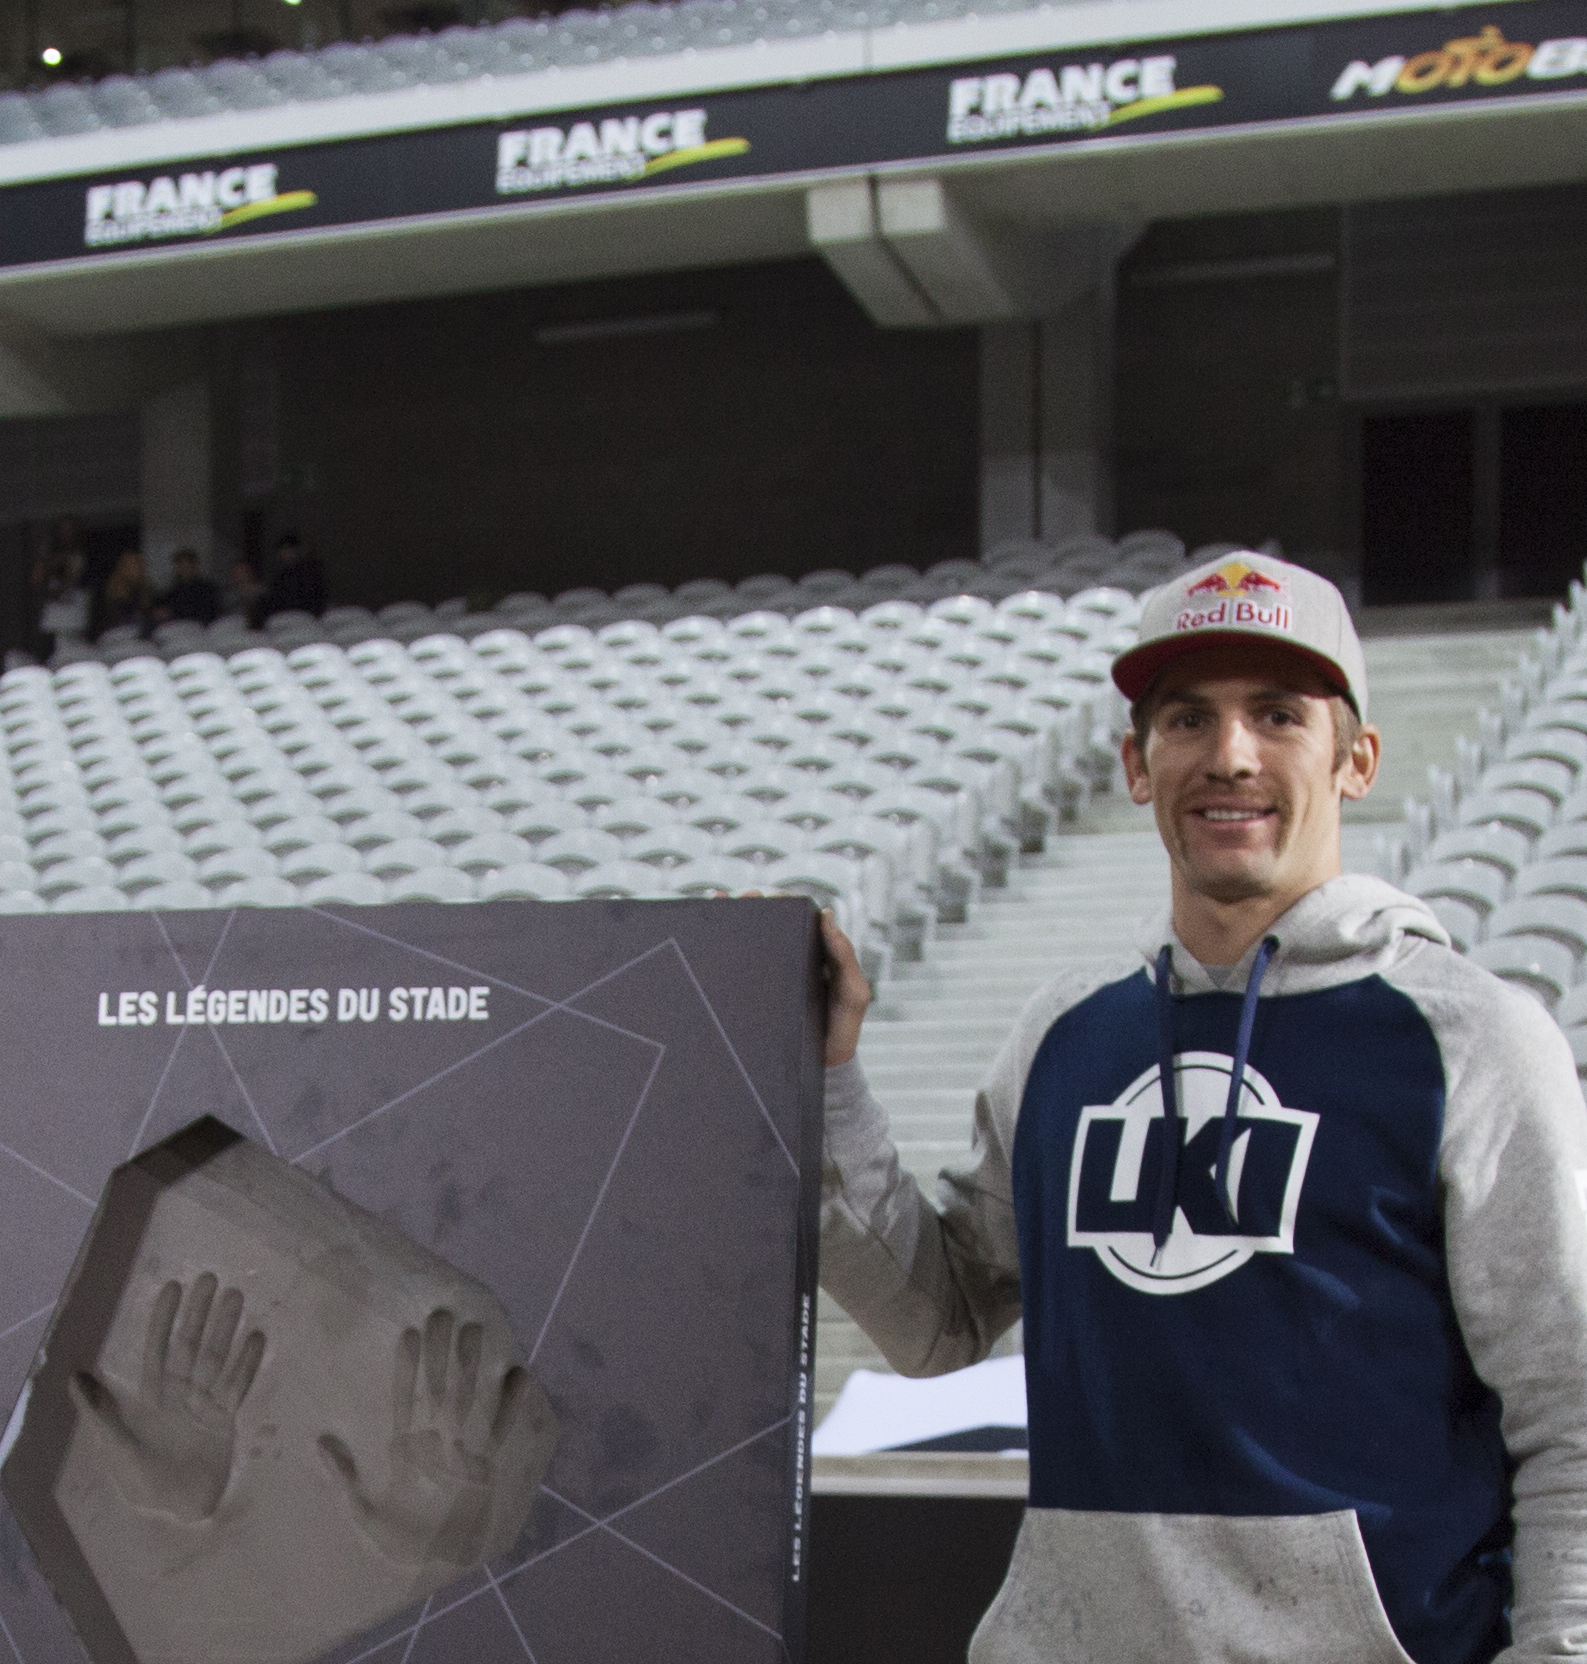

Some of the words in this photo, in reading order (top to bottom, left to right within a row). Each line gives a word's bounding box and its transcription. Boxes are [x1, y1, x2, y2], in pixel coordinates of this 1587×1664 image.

[948, 54, 1177, 118] FRANCE
[498, 108, 708, 168] FRANCE
[85, 162, 279, 222] FRANCE
[1177, 602, 1226, 630] Red
[1236, 602, 1289, 629] Bull
[98, 991, 158, 1026] LES
[165, 985, 329, 1025] LÉGENDES
[337, 987, 380, 1023] DU
[388, 986, 490, 1022] STADE
[791, 1537, 802, 1582] LES
[799, 1371, 807, 1403] DU
